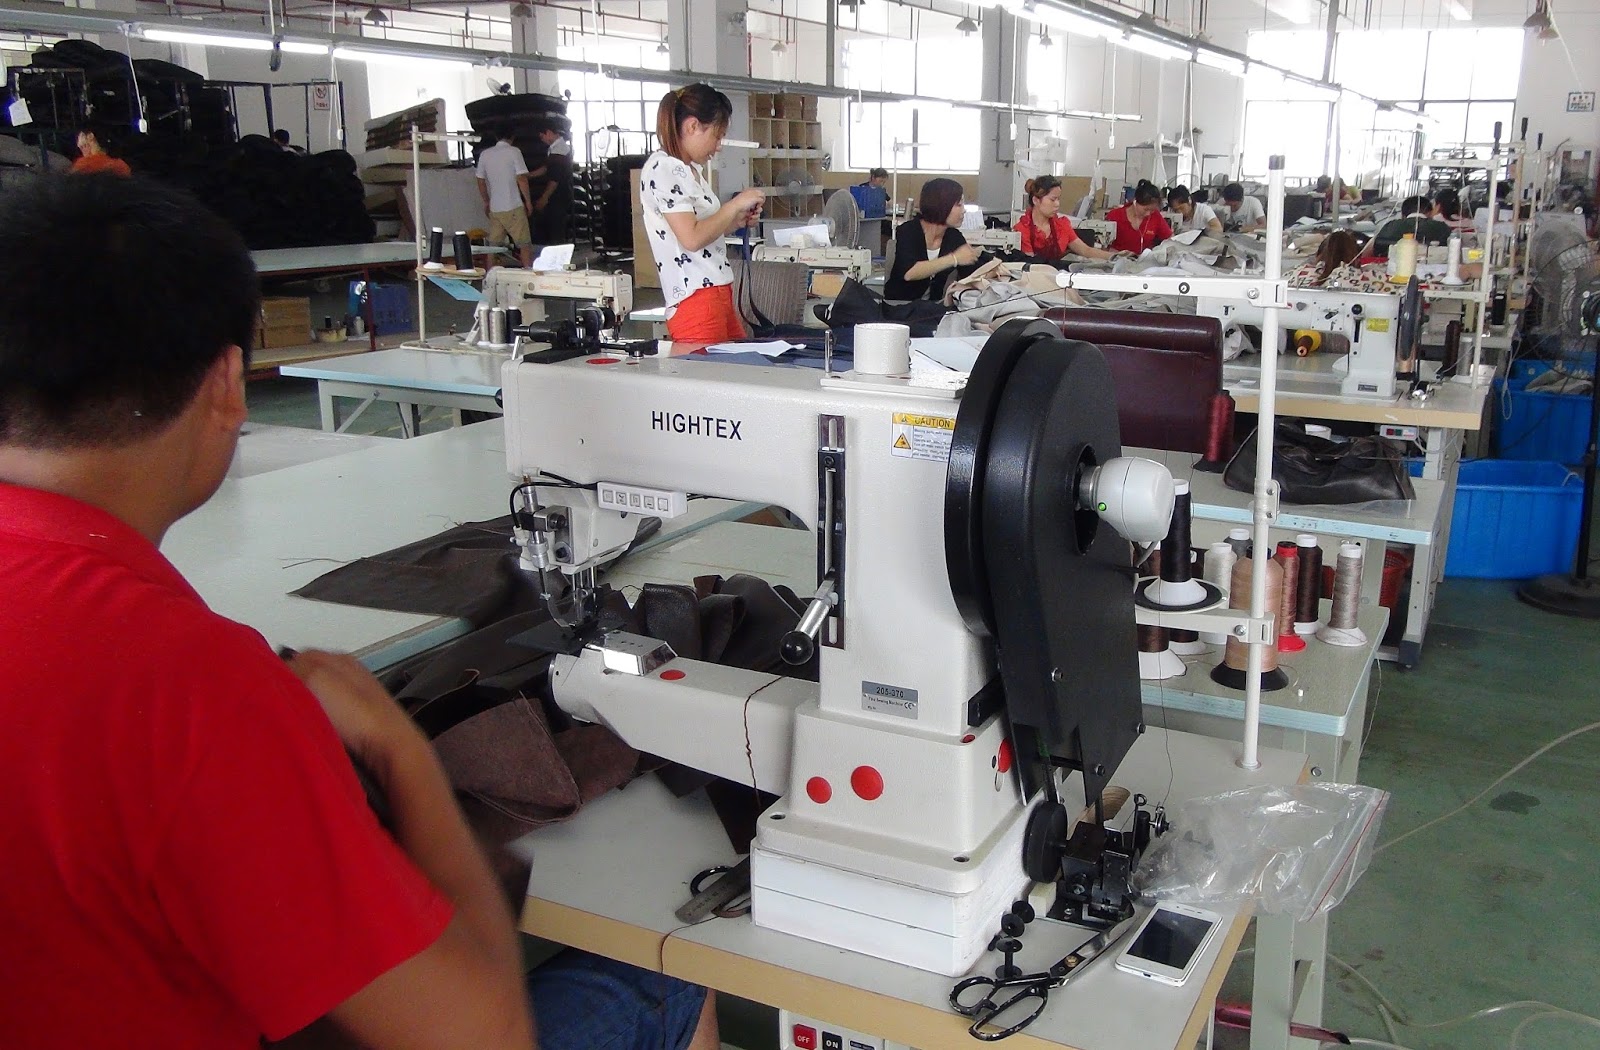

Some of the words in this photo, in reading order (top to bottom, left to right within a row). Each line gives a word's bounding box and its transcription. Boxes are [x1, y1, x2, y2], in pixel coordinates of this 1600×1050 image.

[652, 410, 742, 440] HIGHTEX
[914, 417, 950, 428] CAUTION
[876, 687, 904, 698] 205-370
[797, 1035, 810, 1044] OFF
[826, 1040, 839, 1049] ON
